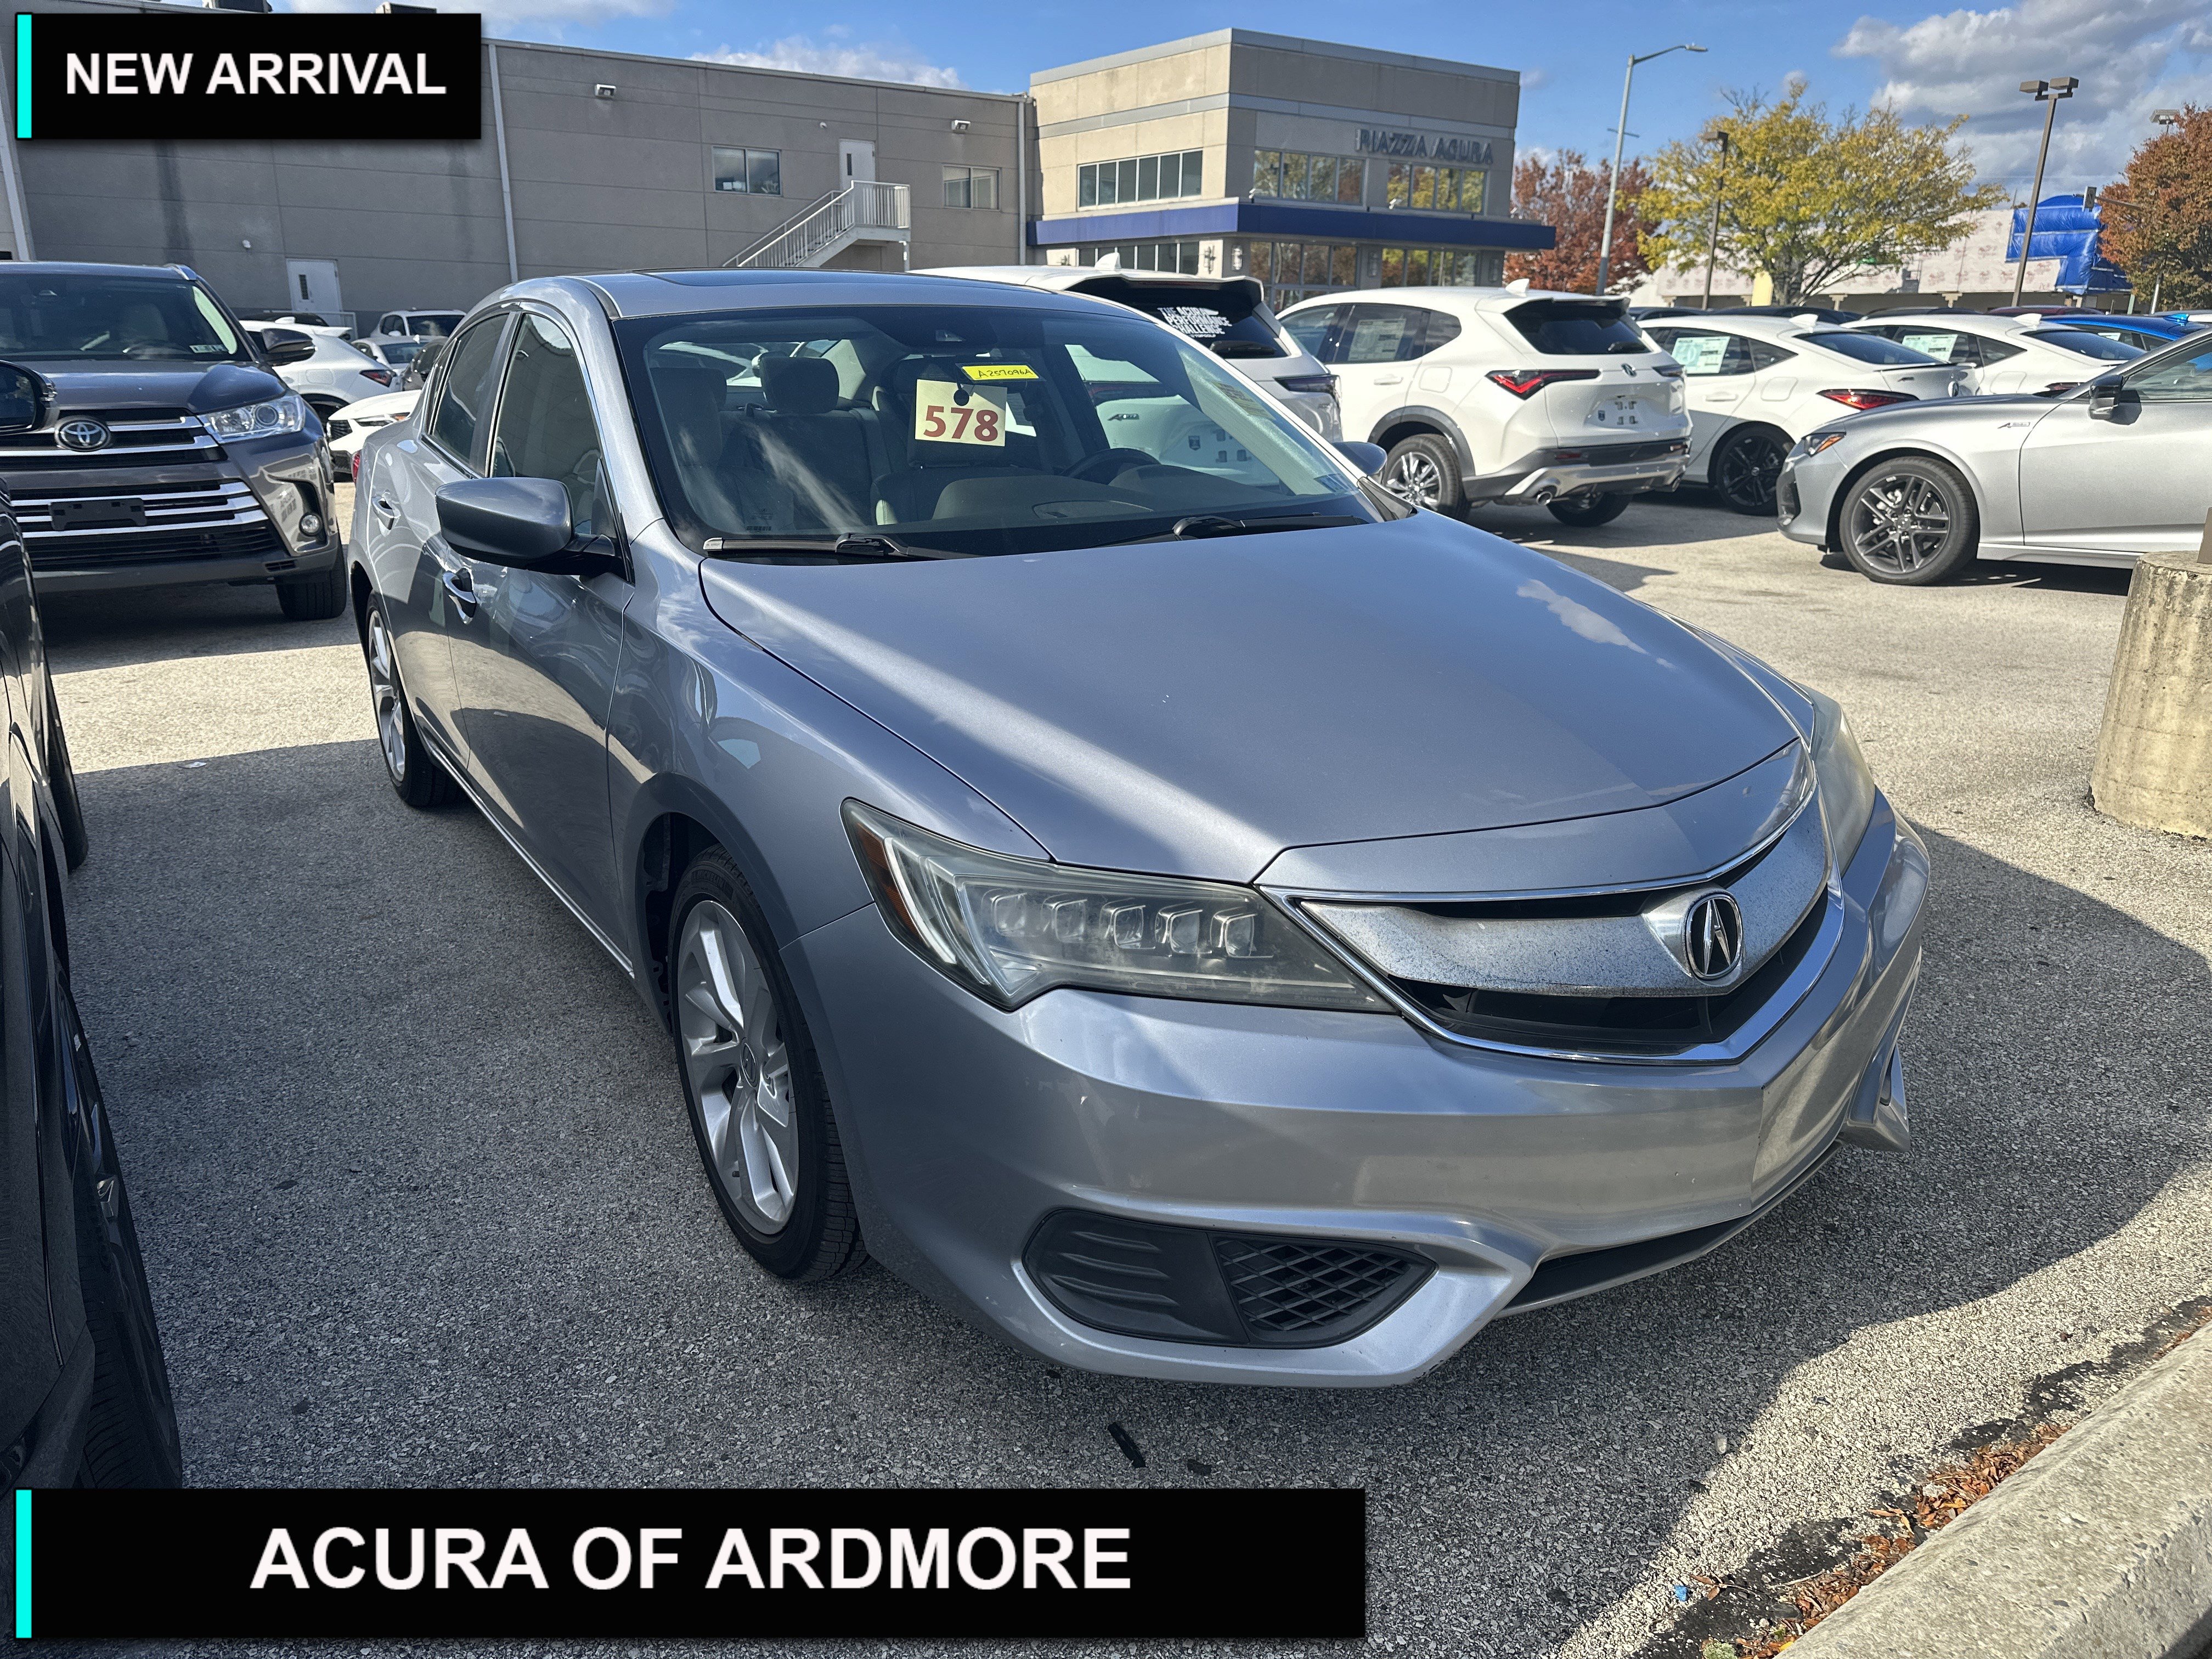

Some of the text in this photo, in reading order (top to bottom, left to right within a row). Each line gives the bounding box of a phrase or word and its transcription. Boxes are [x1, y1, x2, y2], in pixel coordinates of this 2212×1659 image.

[1356, 128, 1493, 165] PIAZZA ACURA
[1157, 307, 1177, 317] THE
[1164, 315, 1232, 326] PERFORMANCE
[923, 405, 998, 442] 578
